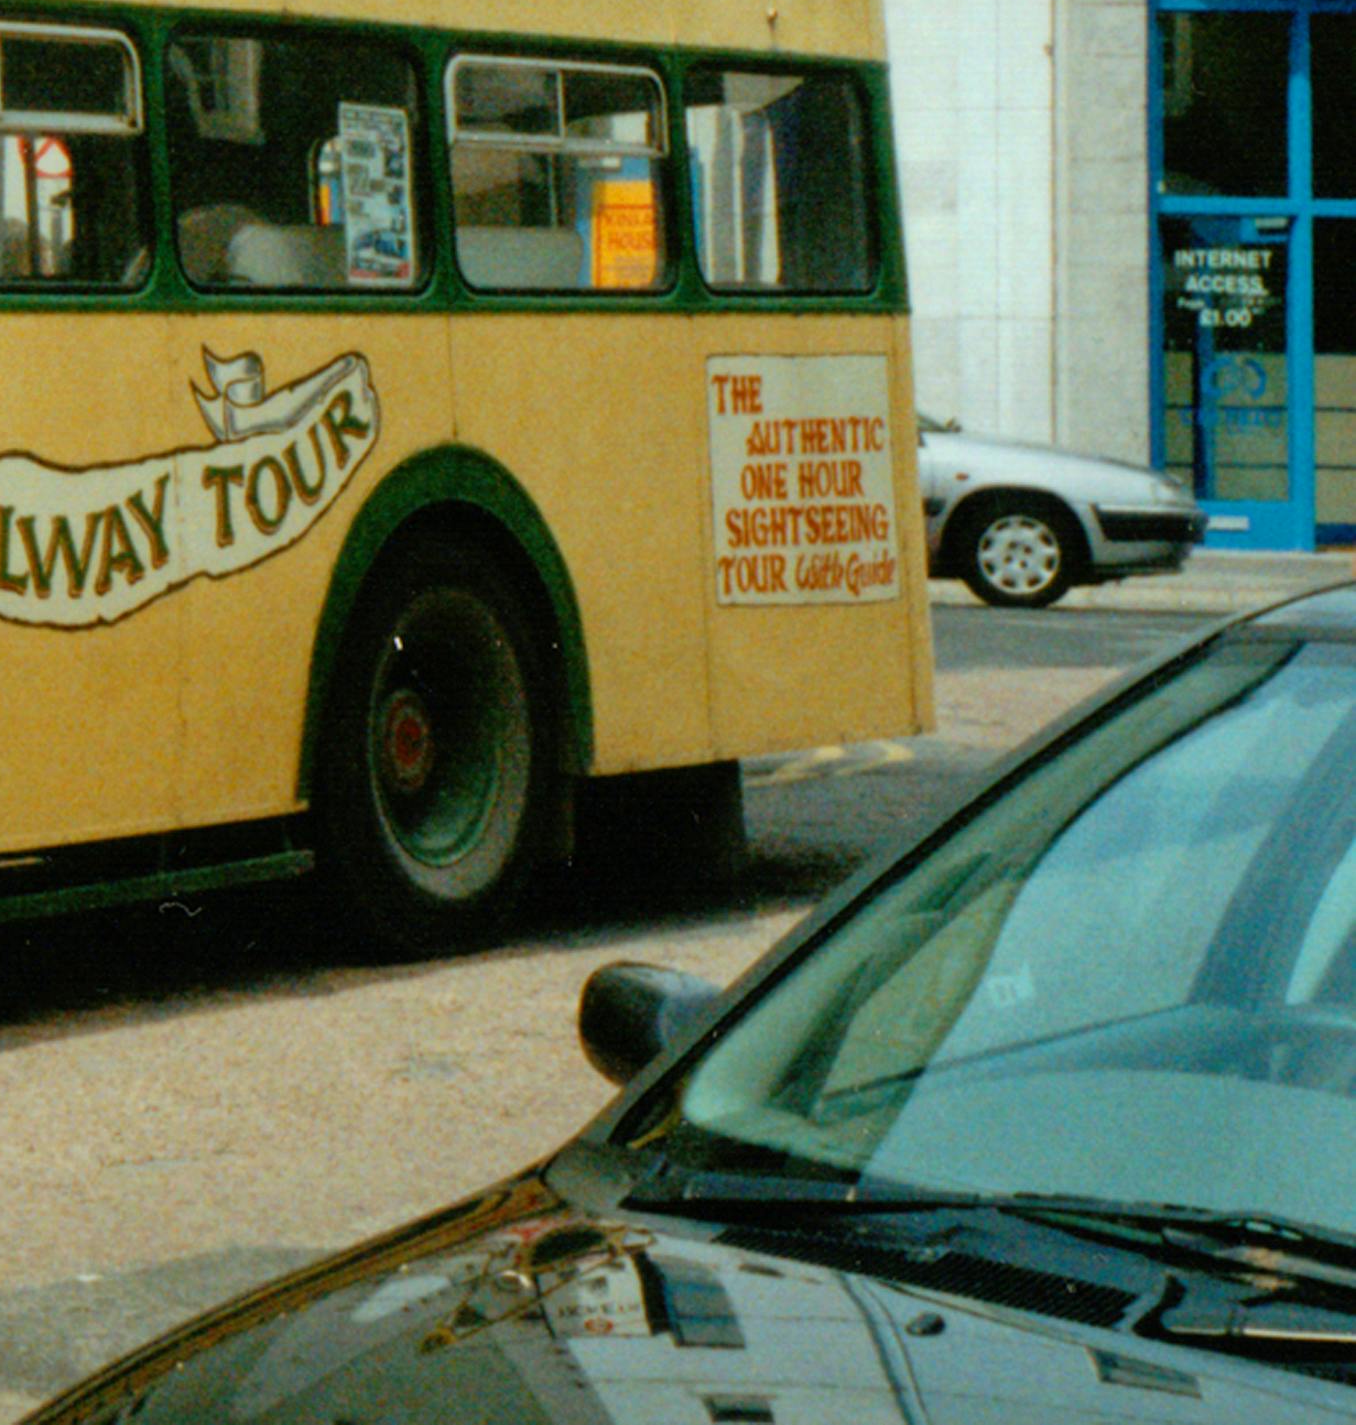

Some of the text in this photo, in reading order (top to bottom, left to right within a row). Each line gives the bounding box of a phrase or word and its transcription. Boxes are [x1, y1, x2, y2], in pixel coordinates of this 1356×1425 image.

[1174, 249, 1273, 268] INTERNET
[1185, 275, 1265, 296] ACCESS
[712, 374, 763, 415] THE
[746, 416, 885, 456] AUTHENTIC
[201, 390, 372, 548] TOUR
[741, 460, 864, 501] ONE HOUR
[725, 503, 889, 548] SIGHTSEEING
[717, 554, 787, 596] TOUR
